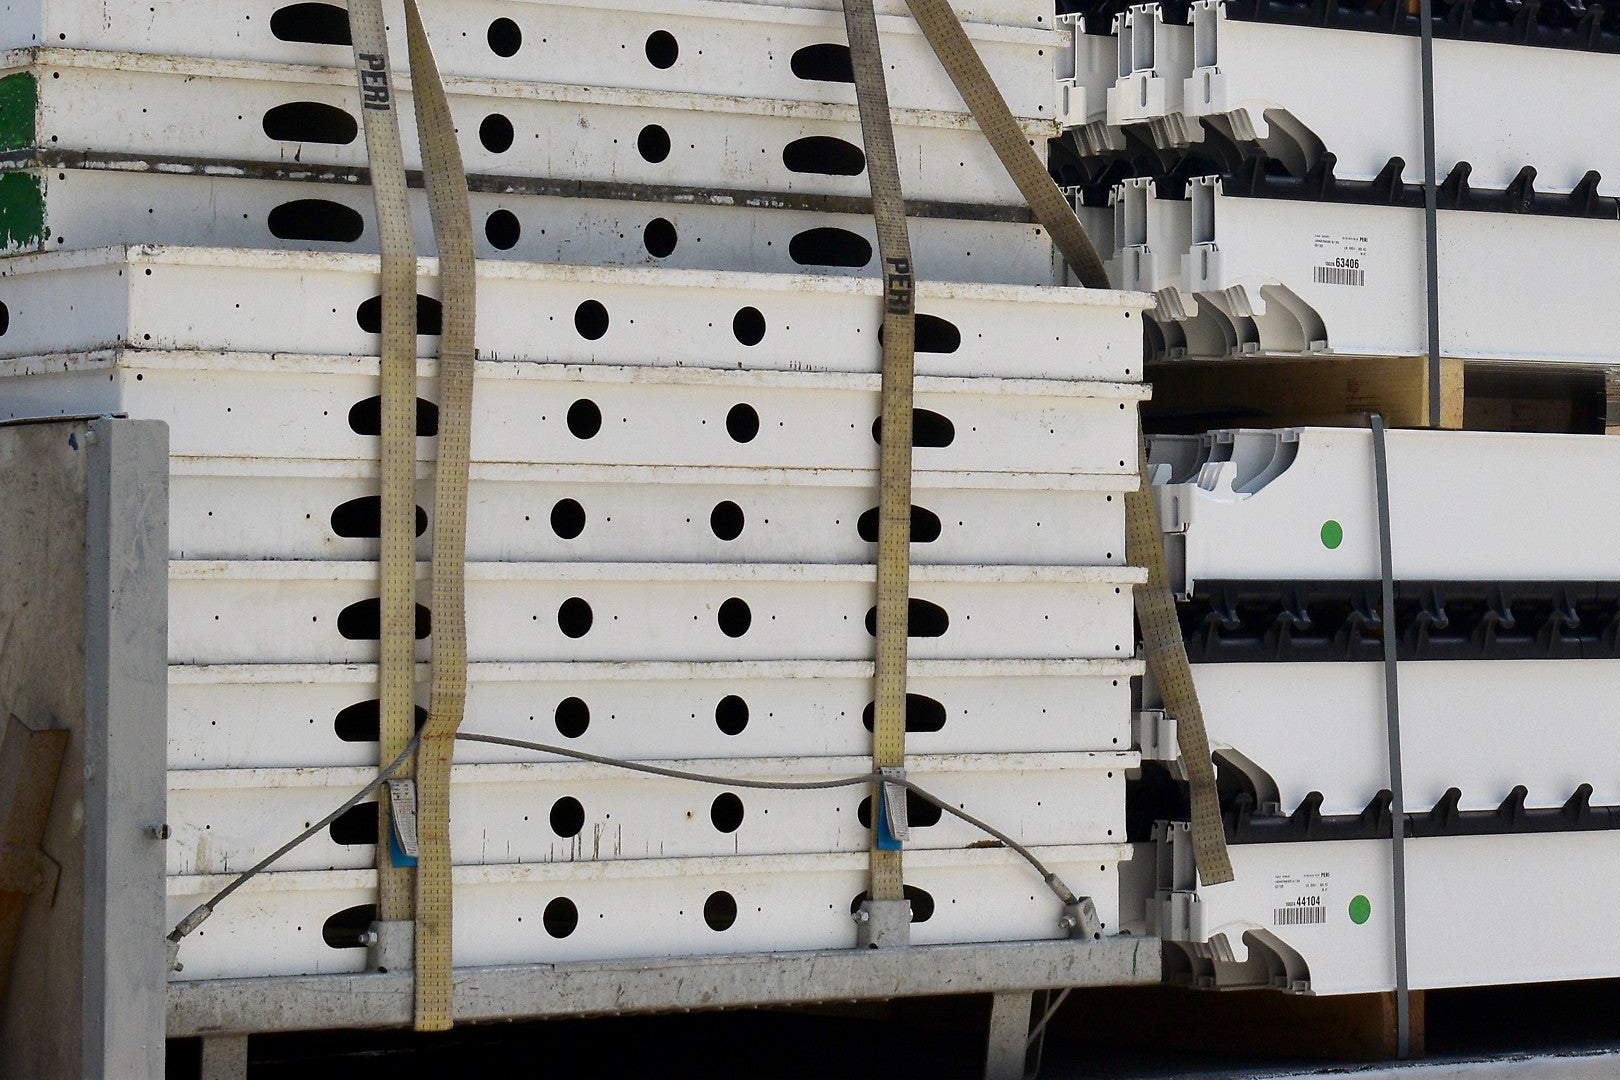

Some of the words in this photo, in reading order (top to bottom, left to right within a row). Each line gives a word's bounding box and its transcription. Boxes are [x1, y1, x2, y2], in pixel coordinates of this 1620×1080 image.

[359, 53, 391, 111] PERI
[1335, 257, 1360, 269] 63406
[1296, 895, 1321, 907] 44104
